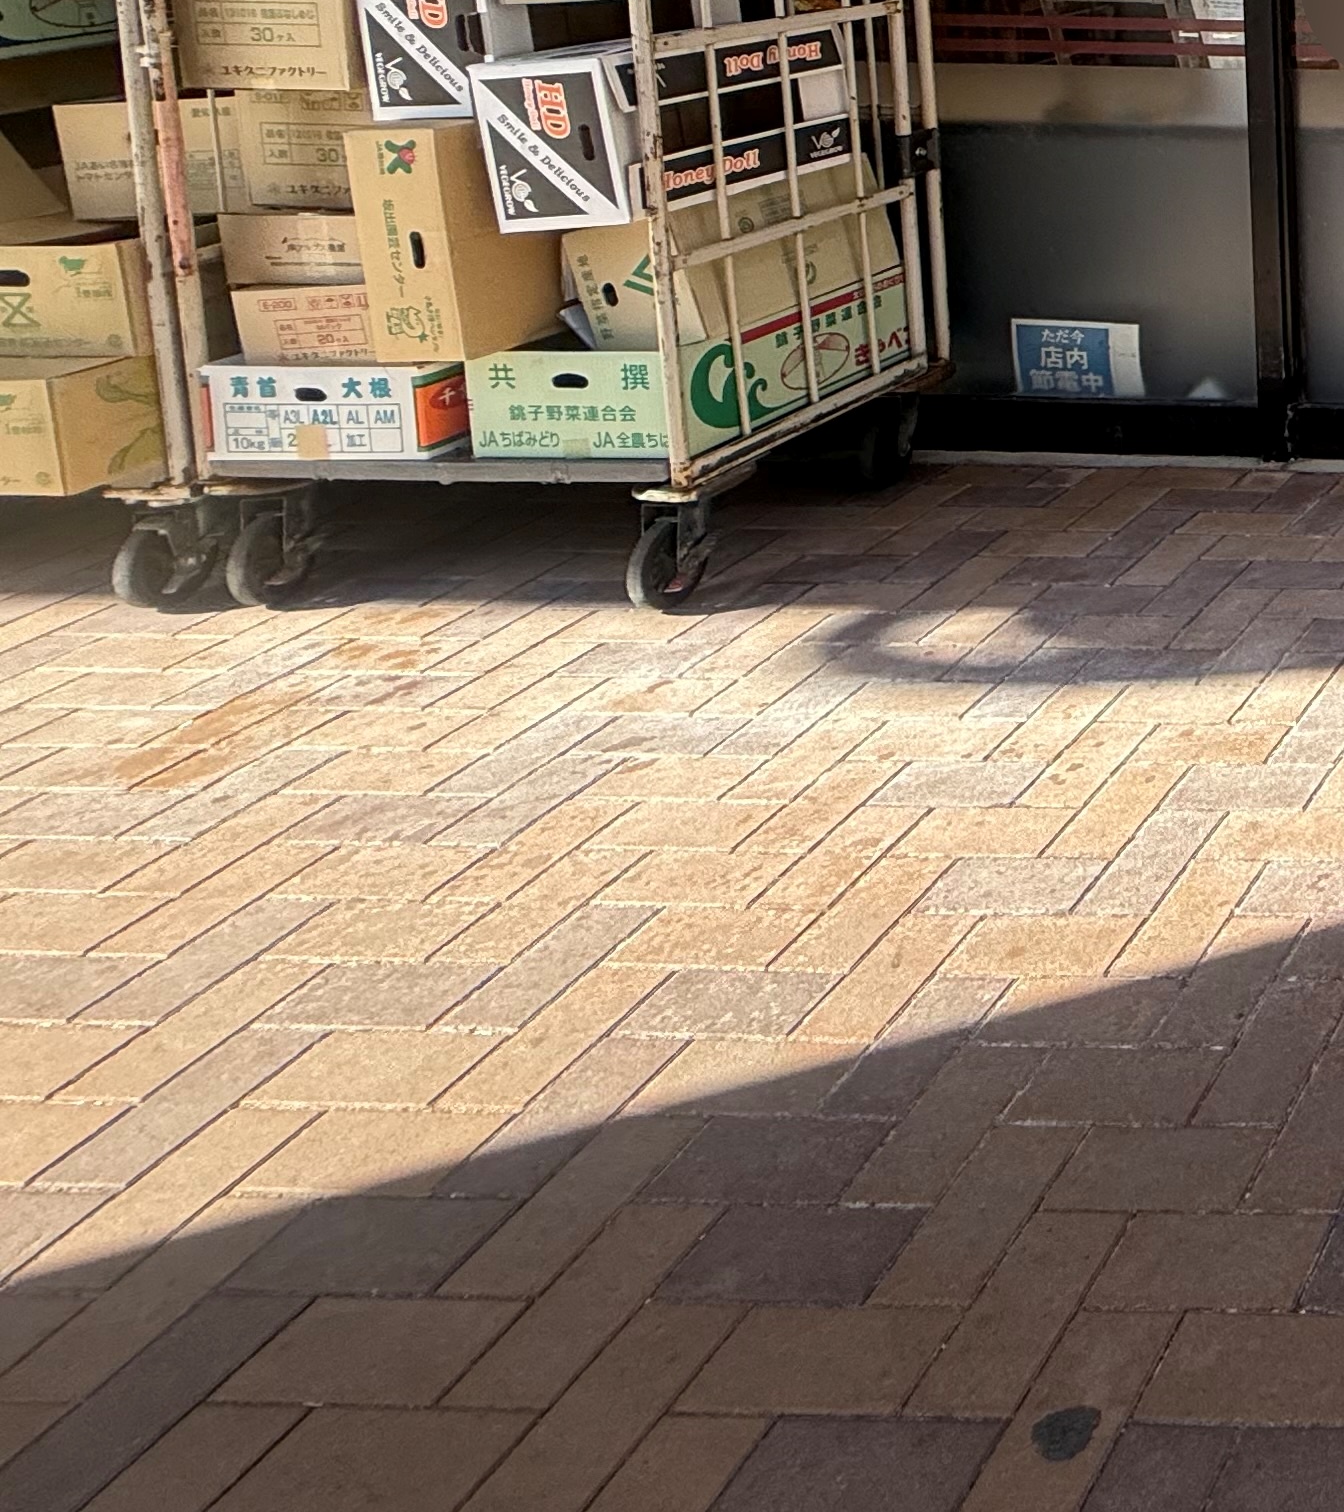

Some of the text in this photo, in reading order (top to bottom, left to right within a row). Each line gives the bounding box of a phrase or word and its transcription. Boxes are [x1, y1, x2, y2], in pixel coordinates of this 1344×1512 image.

[375, 2, 405, 33] Smile
[415, 44, 464, 92] Delicious
[724, 50, 764, 77] Doll
[497, 113, 528, 144] Smile
[539, 155, 591, 203] Delicious
[722, 148, 760, 175] Doll
[1041, 328, 1085, 345] ただ今
[1040, 345, 1089, 370] 店内
[1029, 368, 1104, 393] 節電中
[311, 408, 338, 426] A2L
[346, 409, 364, 425] AL
[374, 410, 396, 425] AM
[508, 404, 637, 423] 銚子野菜連合会
